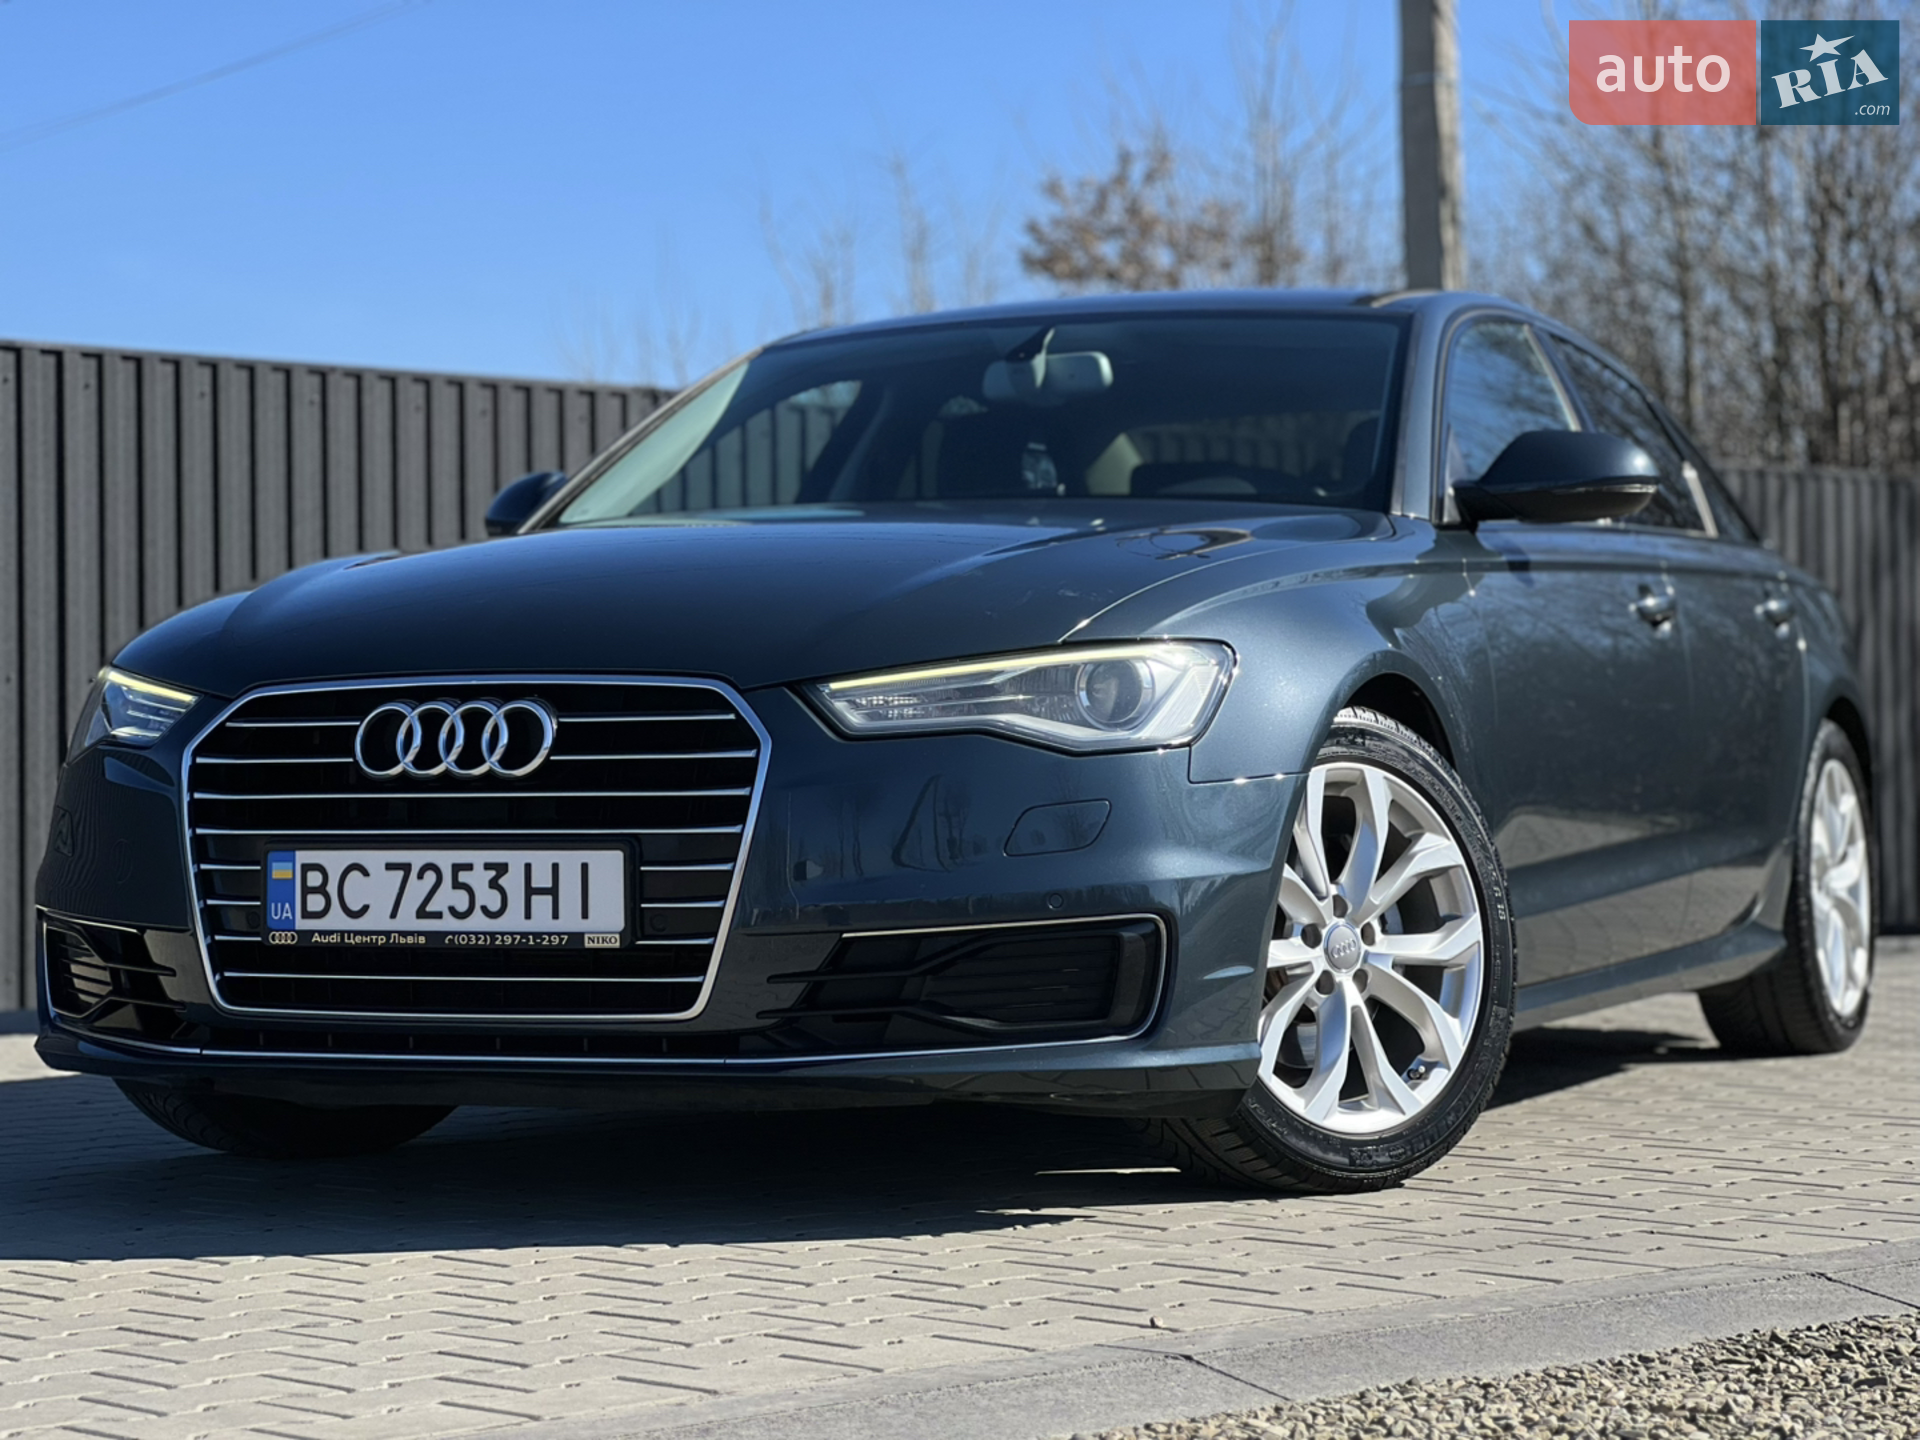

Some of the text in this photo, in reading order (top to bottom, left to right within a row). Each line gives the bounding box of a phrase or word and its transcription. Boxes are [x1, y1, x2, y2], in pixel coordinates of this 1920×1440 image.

[300, 862, 589, 920] BC 7253 HI
[271, 903, 292, 920] UA
[311, 932, 568, 946] Audi Центр Львів (032) 297-1-297
[587, 935, 618, 945] NIKO
